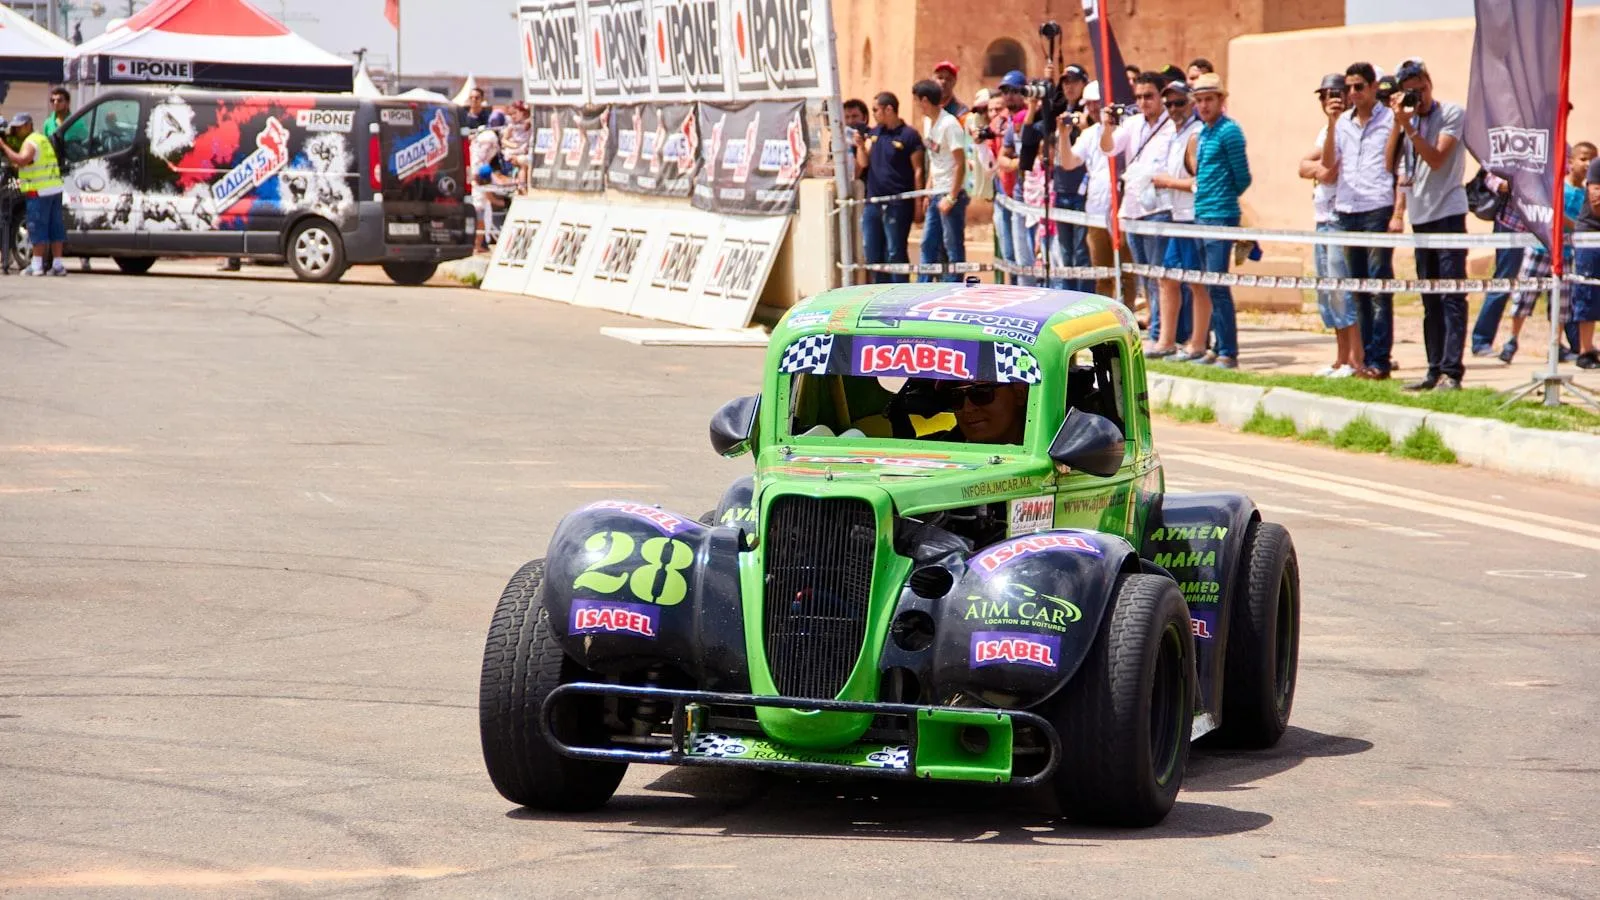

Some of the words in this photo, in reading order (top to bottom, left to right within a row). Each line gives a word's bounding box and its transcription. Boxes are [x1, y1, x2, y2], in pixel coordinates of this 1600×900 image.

[531, 16, 579, 80] IPONE
[600, 9, 648, 80] IPONE
[665, 1, 719, 75] IPONE
[747, 0, 812, 72] IPONE
[130, 61, 188, 77] IPONE
[309, 110, 351, 125] IPONE
[717, 248, 764, 291] IPONE
[952, 313, 1038, 332] IPONE
[994, 328, 1036, 344] IPONE
[861, 343, 970, 379] ISABEL
[1150, 525, 1228, 541] AYMEN
[979, 535, 1095, 572] ISABEL
[1153, 551, 1216, 568] MAHA
[573, 531, 694, 606] 28
[575, 608, 653, 635] ISABEL
[1017, 602, 1066, 625] CAR
[976, 640, 1055, 666] ISABEL
